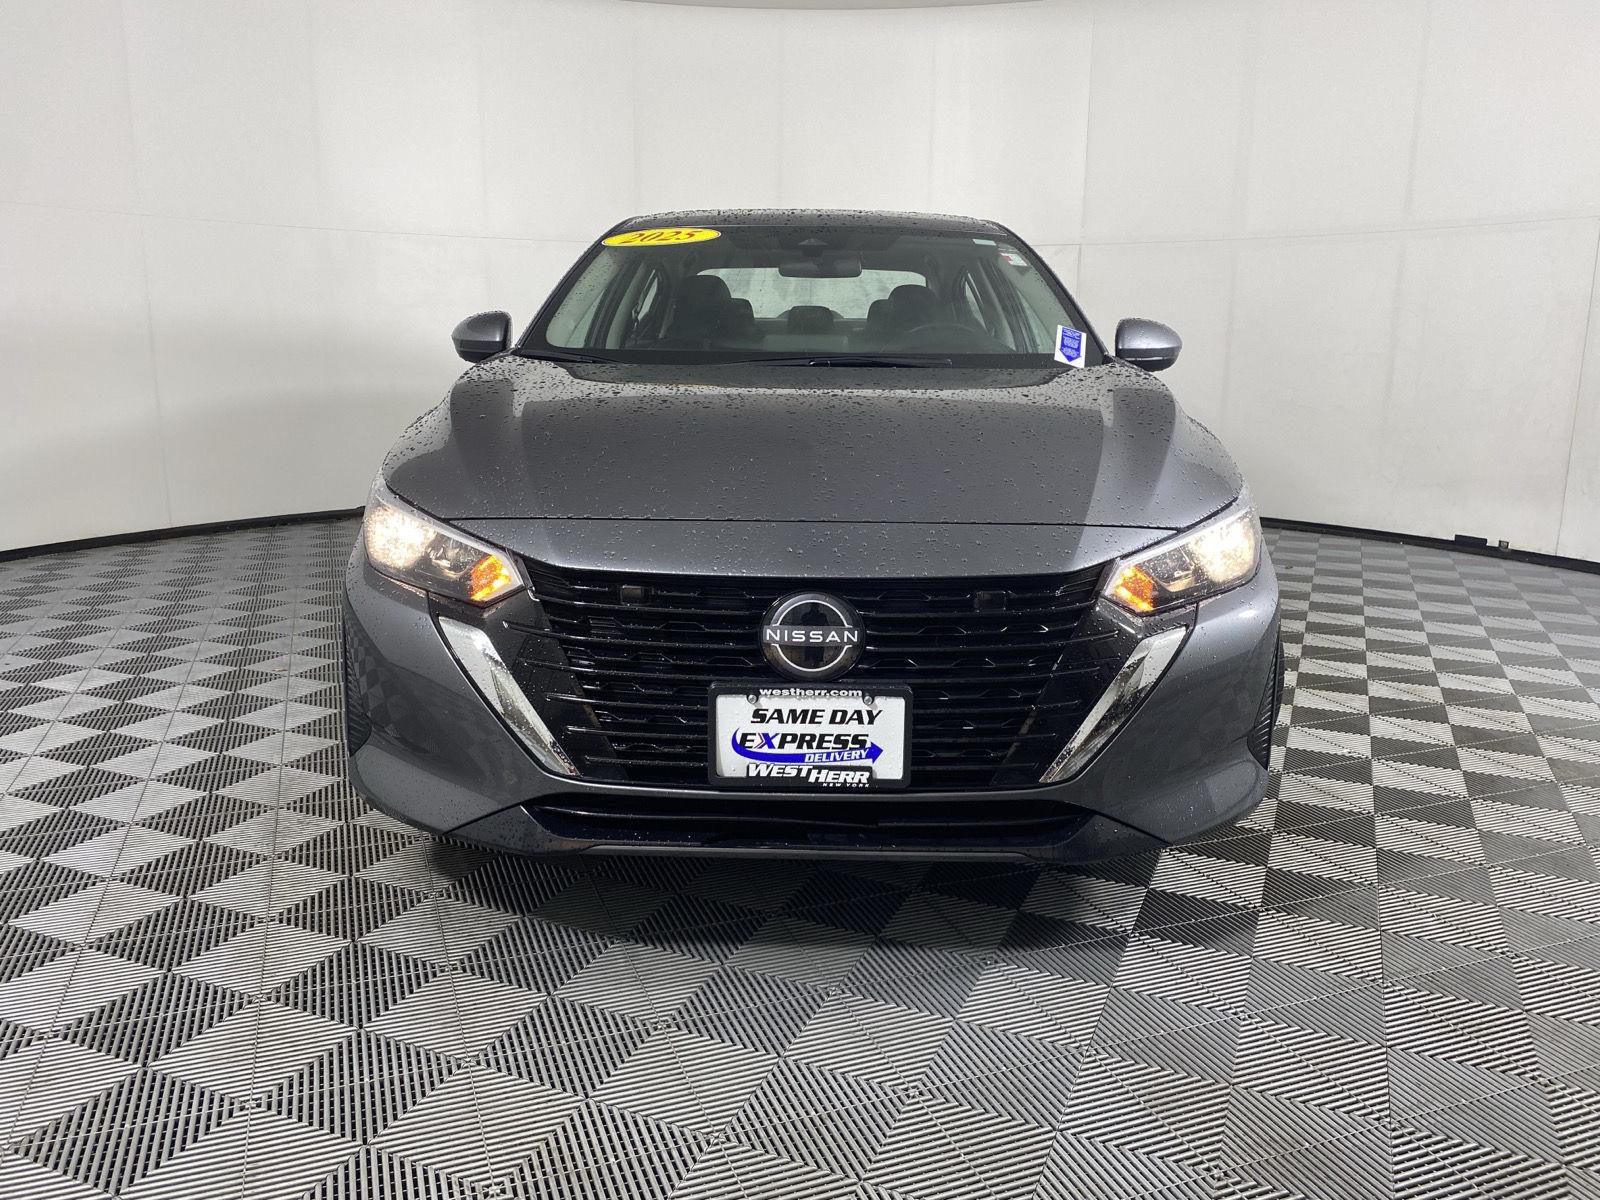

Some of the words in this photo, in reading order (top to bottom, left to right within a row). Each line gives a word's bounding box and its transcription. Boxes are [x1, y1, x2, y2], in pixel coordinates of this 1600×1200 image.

[618, 230, 703, 244] 2025
[766, 629, 858, 643] NISSAN
[759, 687, 863, 697] westherr.com
[750, 708, 824, 724] SAME
[828, 709, 883, 725] DAY
[739, 732, 868, 750] EXPRESS
[804, 749, 868, 763] DELIVERY
